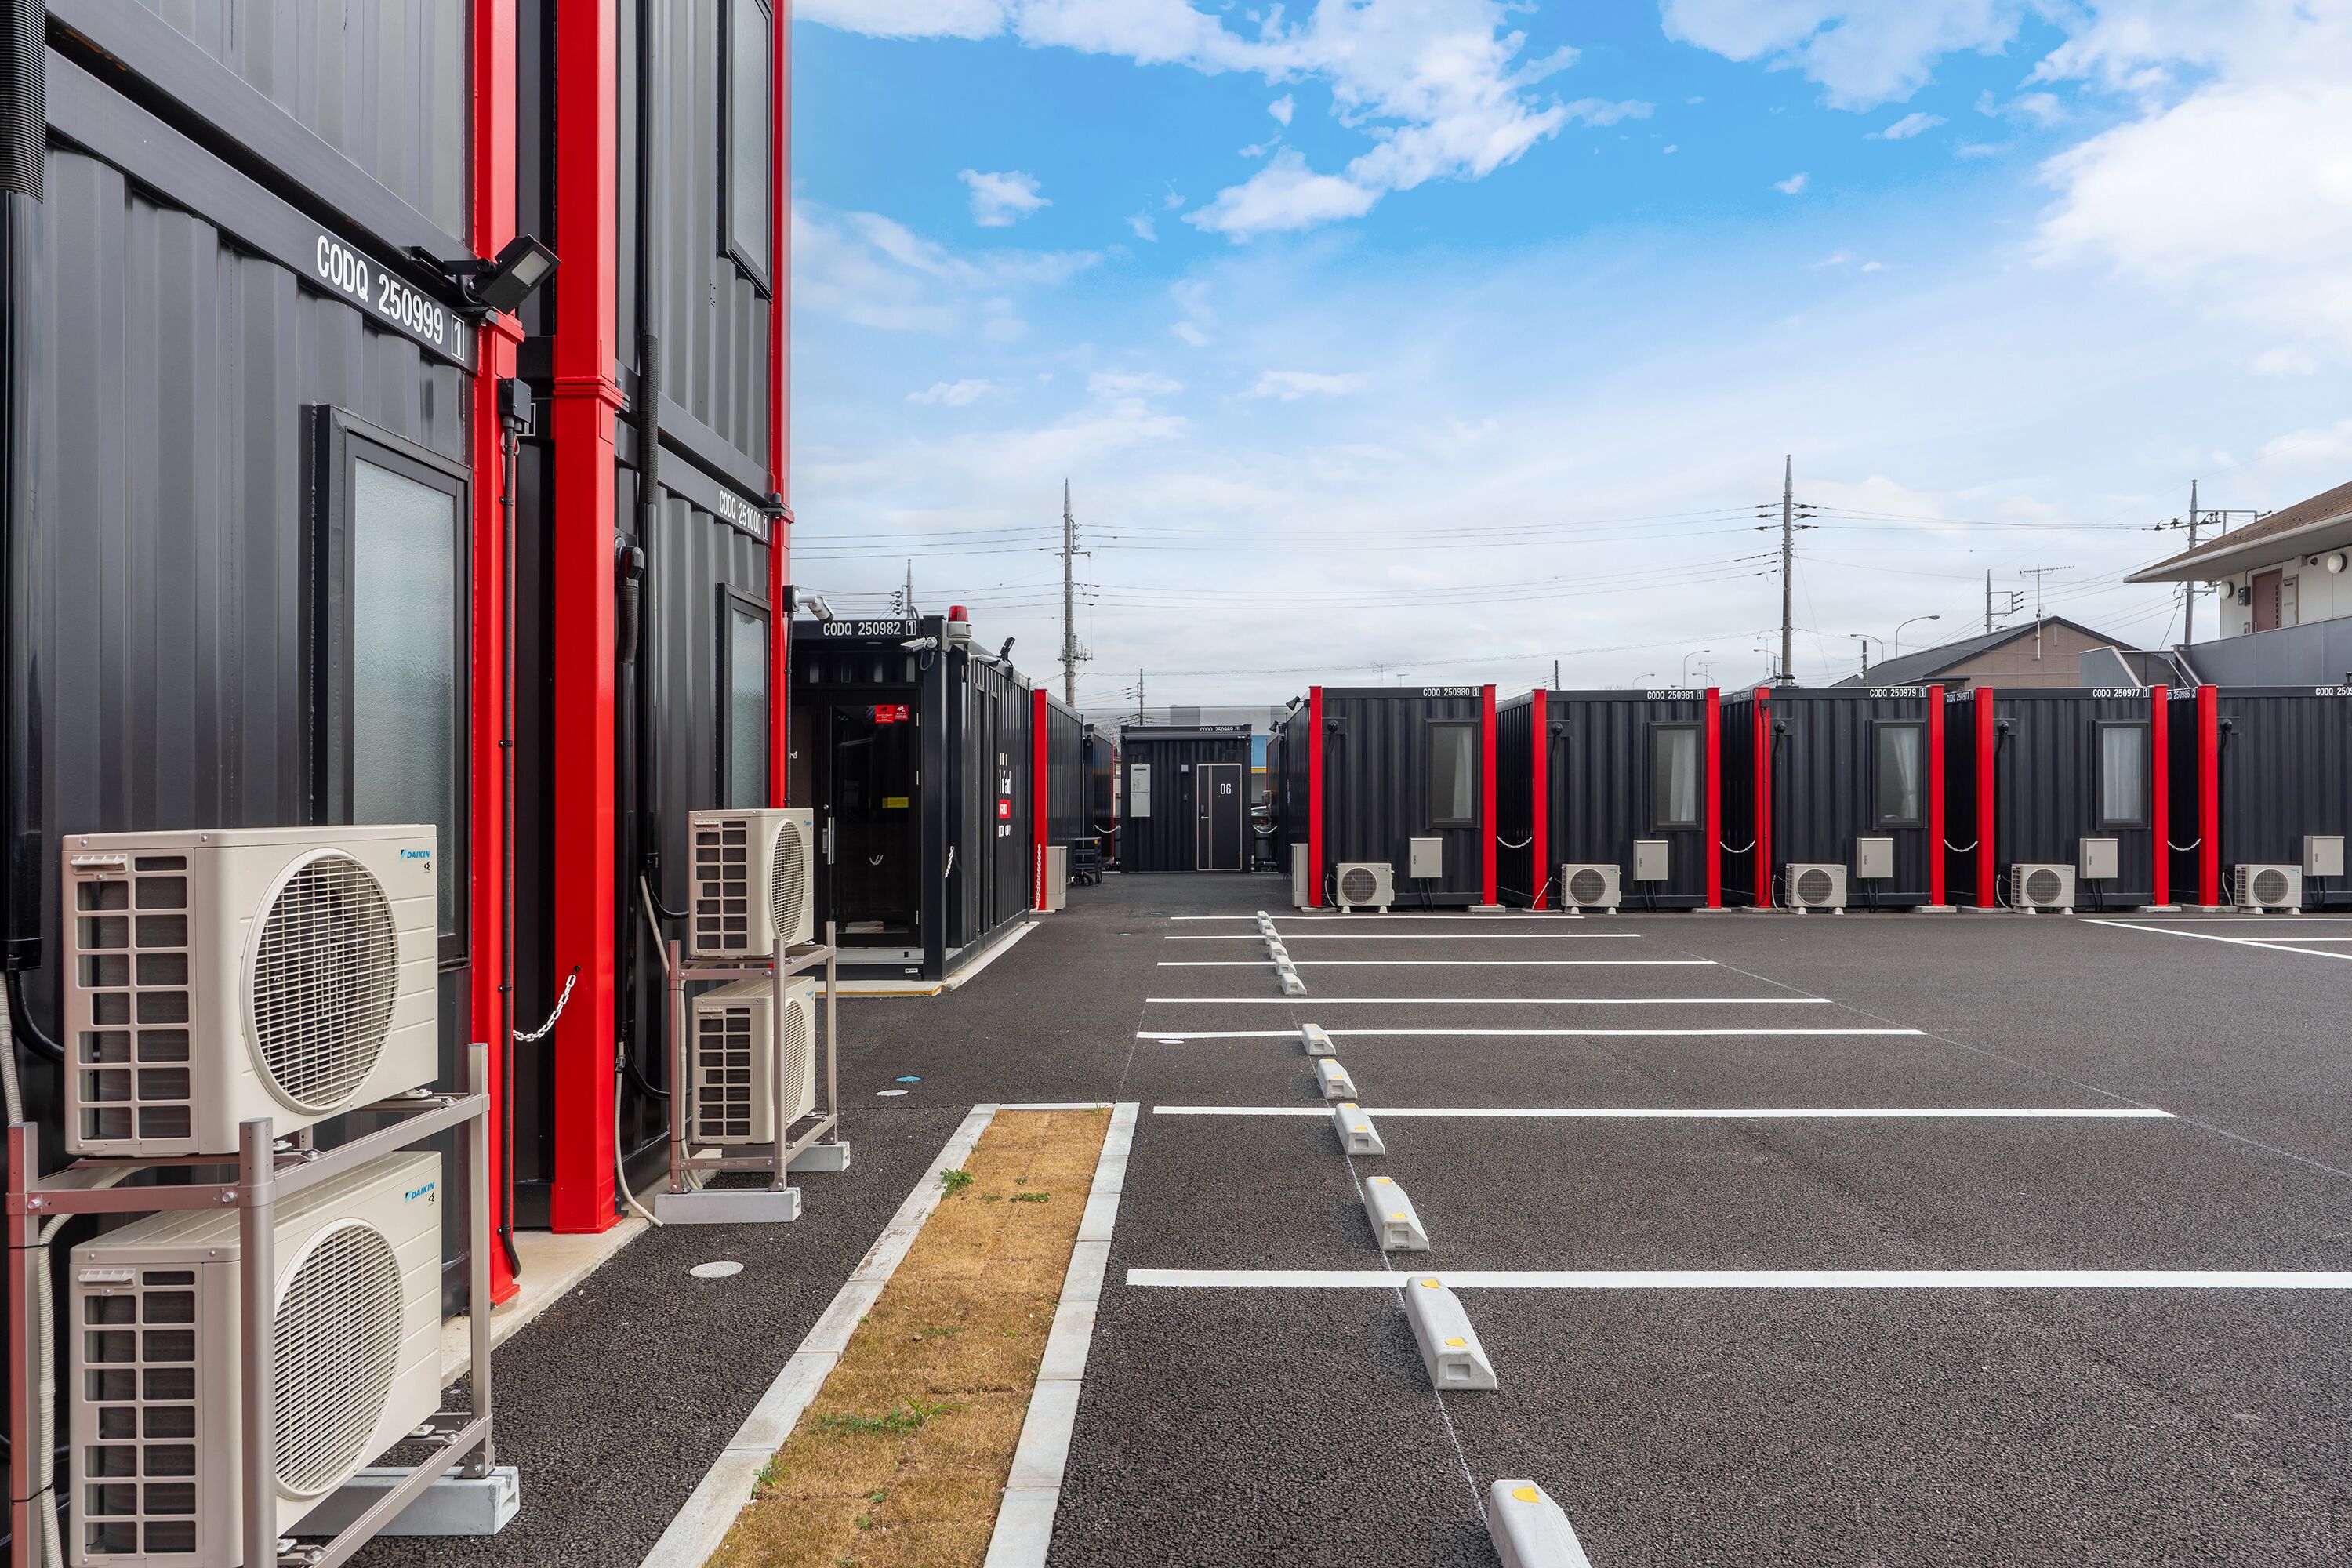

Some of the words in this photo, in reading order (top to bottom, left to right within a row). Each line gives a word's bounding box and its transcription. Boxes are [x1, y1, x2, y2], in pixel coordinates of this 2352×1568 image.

[317, 235, 368, 303] CODQ
[378, 274, 444, 345] 250999
[719, 490, 736, 519] CODQ
[739, 502, 761, 534] 251000
[823, 622, 852, 636] CODQ
[858, 622, 901, 636] 250982
[1423, 688, 1441, 697] CODQ
[1443, 688, 1470, 697] 250980
[1647, 691, 1665, 700] CODQ
[1668, 691, 1693, 699] 250981
[1869, 688, 1888, 698] CODQ
[1890, 688, 1917, 697] 250979
[2092, 688, 2111, 698] CODQ
[2114, 688, 2140, 697] 250977
[2315, 687, 2334, 696] CODQ
[1220, 783, 1232, 794] 06
[407, 850, 430, 859] DAIKIN
[411, 1181, 435, 1200] DAIKIN
